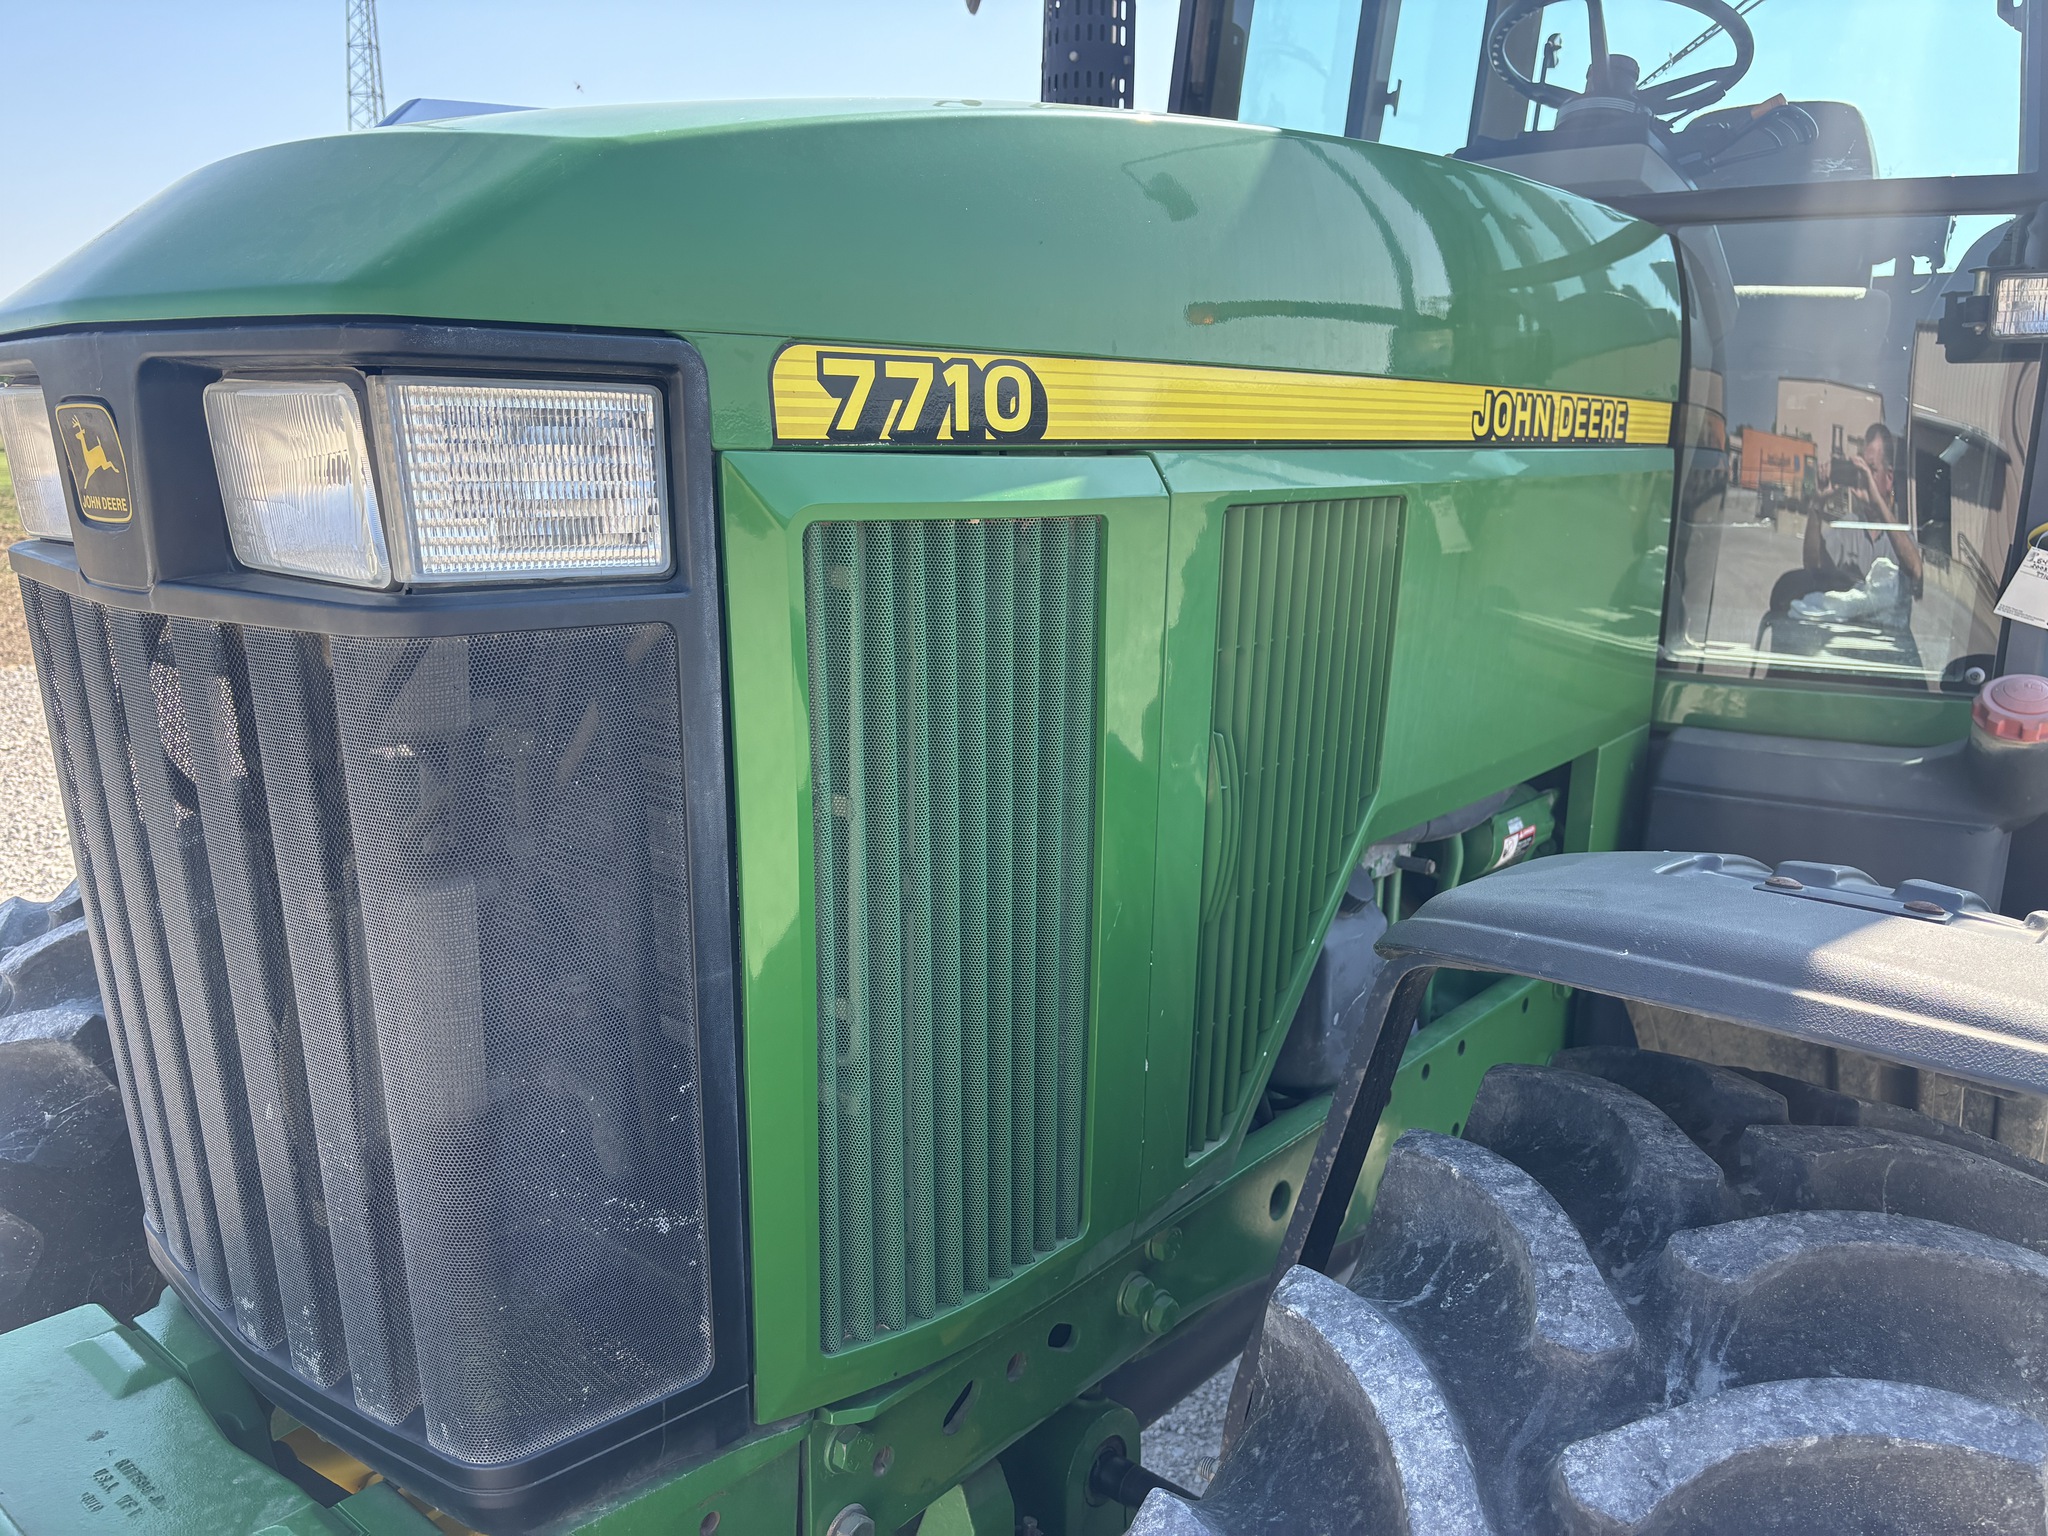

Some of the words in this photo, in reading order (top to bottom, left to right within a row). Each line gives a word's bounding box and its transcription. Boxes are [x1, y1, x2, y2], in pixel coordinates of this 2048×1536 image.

[819, 353, 1038, 437] 7710
[1472, 390, 1554, 439] JOHN
[1557, 396, 1628, 441] DEERE
[83, 496, 101, 509] JOHN
[102, 497, 128, 511] DEERE
